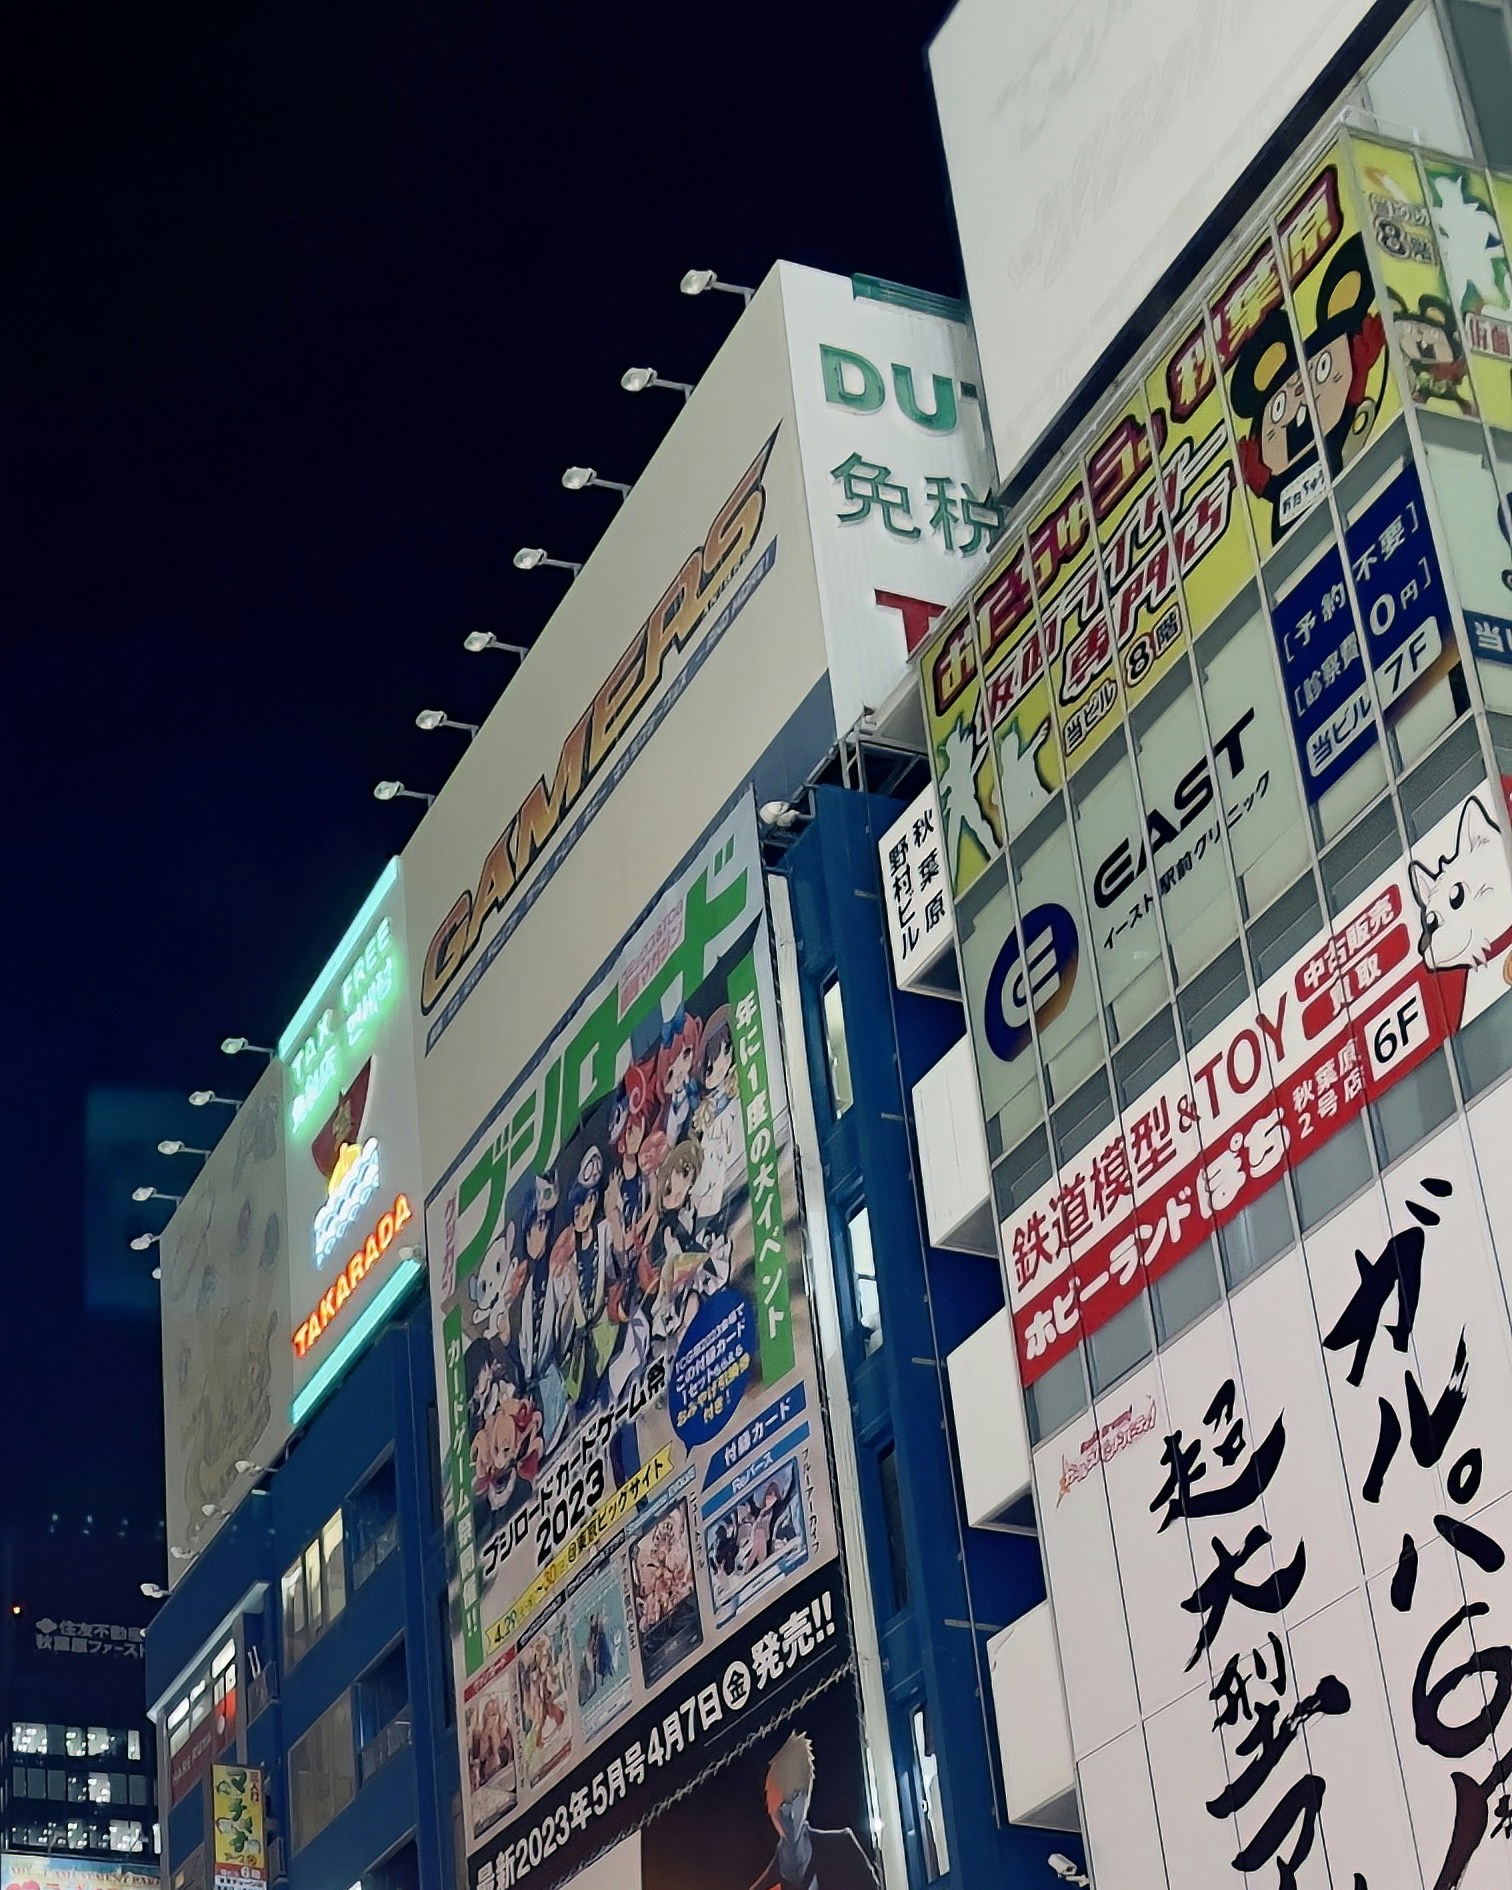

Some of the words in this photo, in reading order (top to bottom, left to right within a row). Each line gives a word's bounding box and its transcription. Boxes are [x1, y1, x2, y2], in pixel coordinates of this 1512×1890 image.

[830, 453, 1007, 560] 免税
[422, 418, 782, 1016] GAMERS
[1065, 678, 1117, 756] 当ビル
[1310, 694, 1372, 770] 当ビル
[1384, 630, 1428, 695] 7F
[1093, 706, 1256, 910] EAST
[888, 836, 920, 961] 野村ビル
[912, 809, 946, 933] 秋葉原
[1302, 890, 1397, 989] 中古販売
[1374, 996, 1419, 1063] 6F
[292, 1193, 413, 1357] TAKARADA
[534, 1455, 604, 1566] 2023
